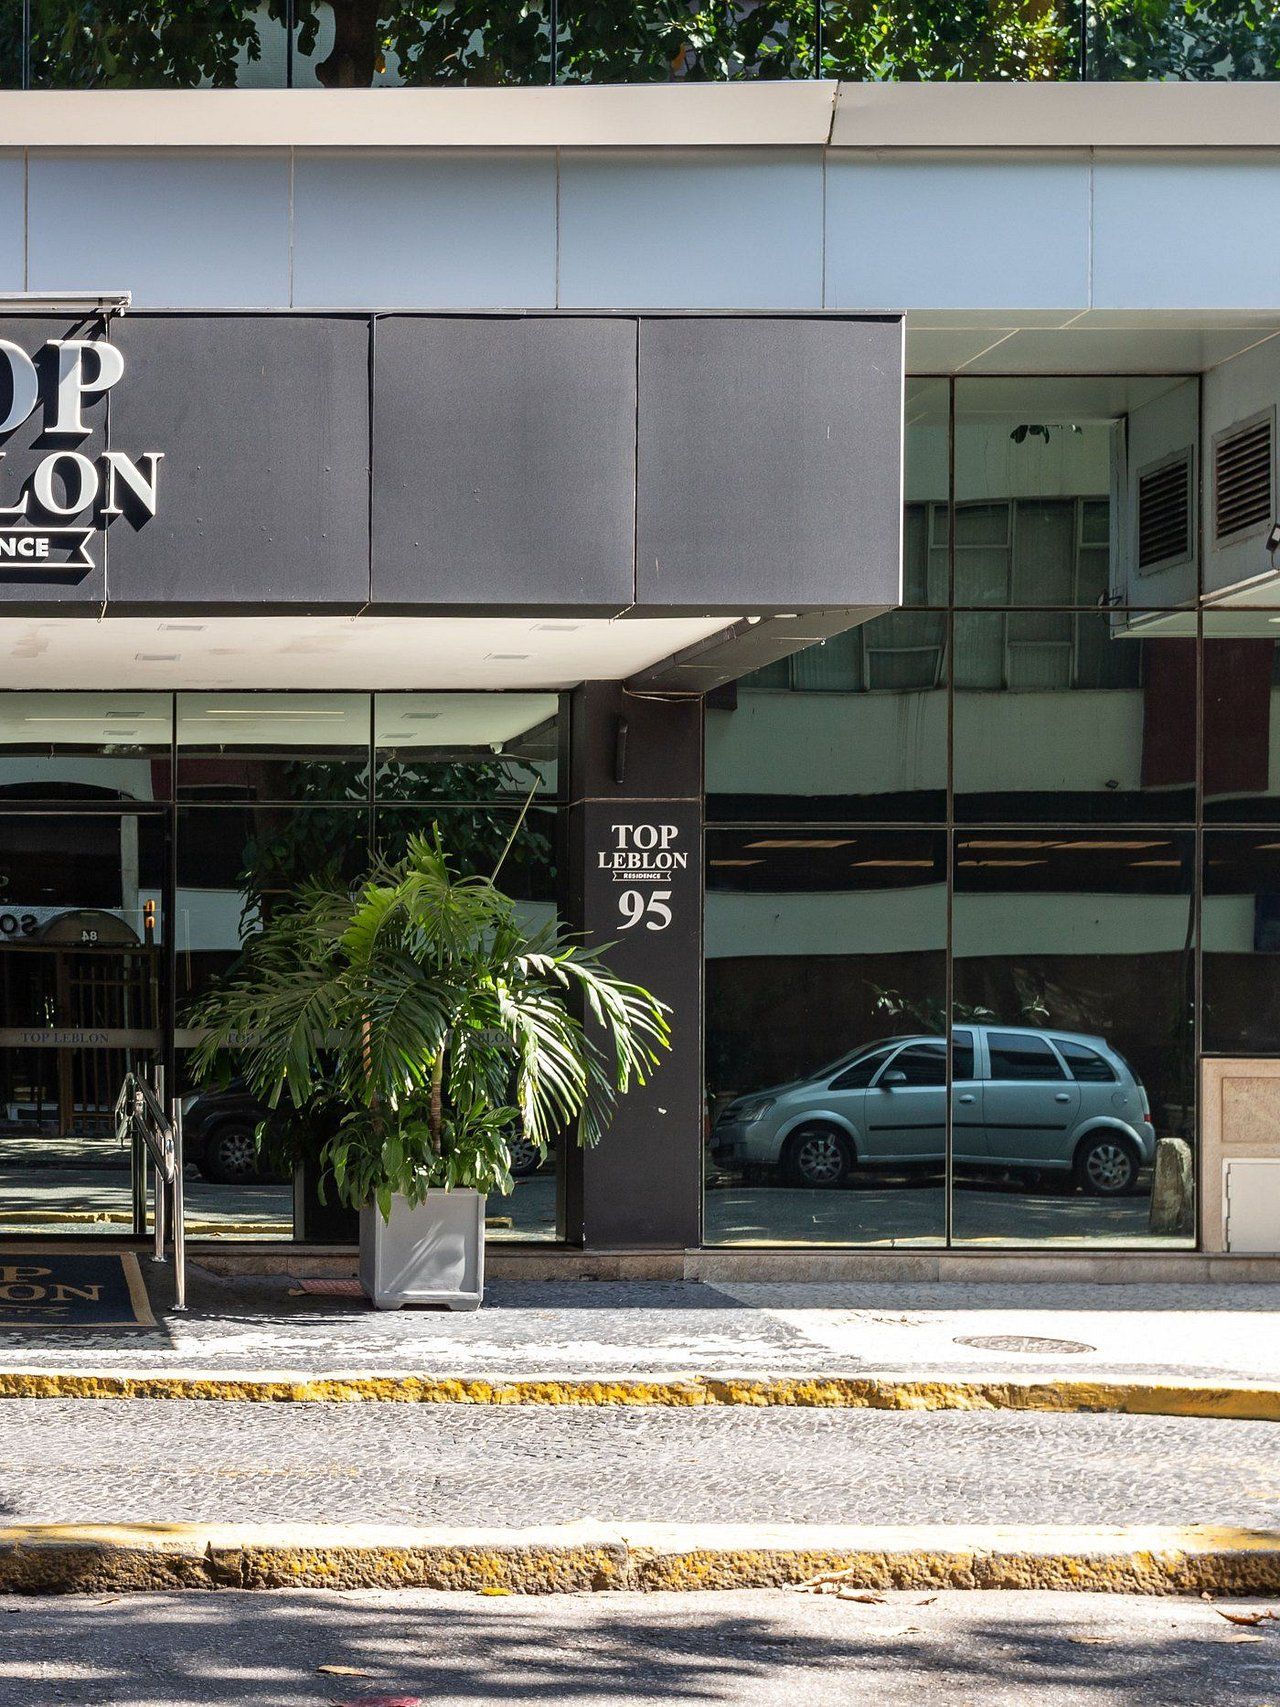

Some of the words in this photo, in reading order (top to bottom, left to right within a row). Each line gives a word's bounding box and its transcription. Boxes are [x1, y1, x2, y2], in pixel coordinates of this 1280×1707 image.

[611, 824, 679, 849] TOP
[598, 852, 688, 869] LEBLON
[616, 890, 672, 931] 95
[21, 1032, 50, 1042] TOP
[53, 1032, 109, 1042] LEBLON
